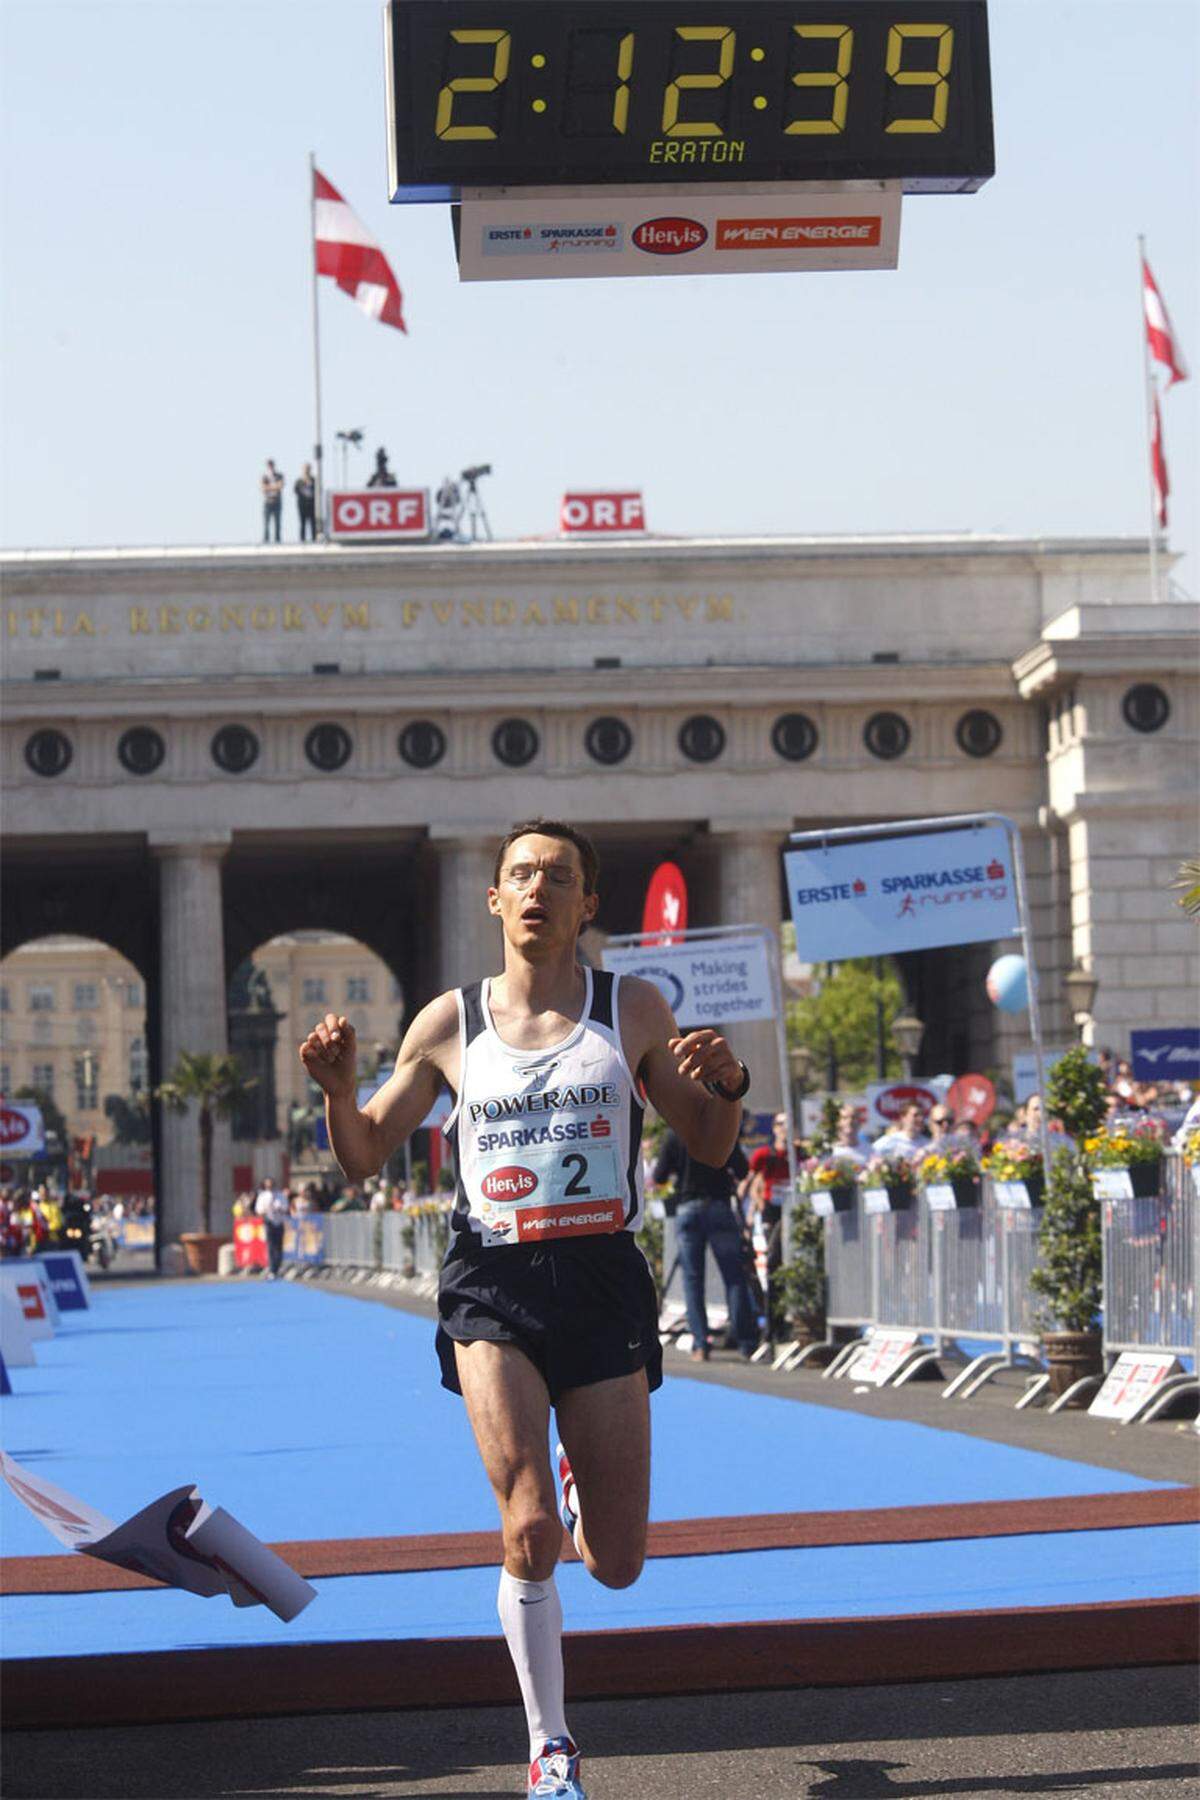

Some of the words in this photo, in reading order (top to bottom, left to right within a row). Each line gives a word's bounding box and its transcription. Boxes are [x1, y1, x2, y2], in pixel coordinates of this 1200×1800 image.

[649, 140, 745, 164] ERATON
[488, 229, 522, 241] ERSTE
[540, 227, 604, 239] SPARKASSE
[640, 226, 702, 247] Hervis
[723, 227, 780, 242] WIEN
[781, 224, 872, 241] ENERGIE
[337, 501, 419, 526] ORF
[562, 500, 642, 526] ORF
[797, 884, 850, 906] ERSTE
[881, 865, 985, 896] SPARKASSE
[691, 960, 748, 977] Making
[694, 980, 748, 997] strides
[696, 997, 764, 1017] together
[470, 1086, 616, 1122] POWERADE
[478, 1121, 589, 1152] SPARKASSE
[485, 1173, 534, 1194] Hervis
[562, 1153, 591, 1196] 2
[523, 1217, 557, 1230] WIEN
[560, 1212, 614, 1227] ENERGIE
